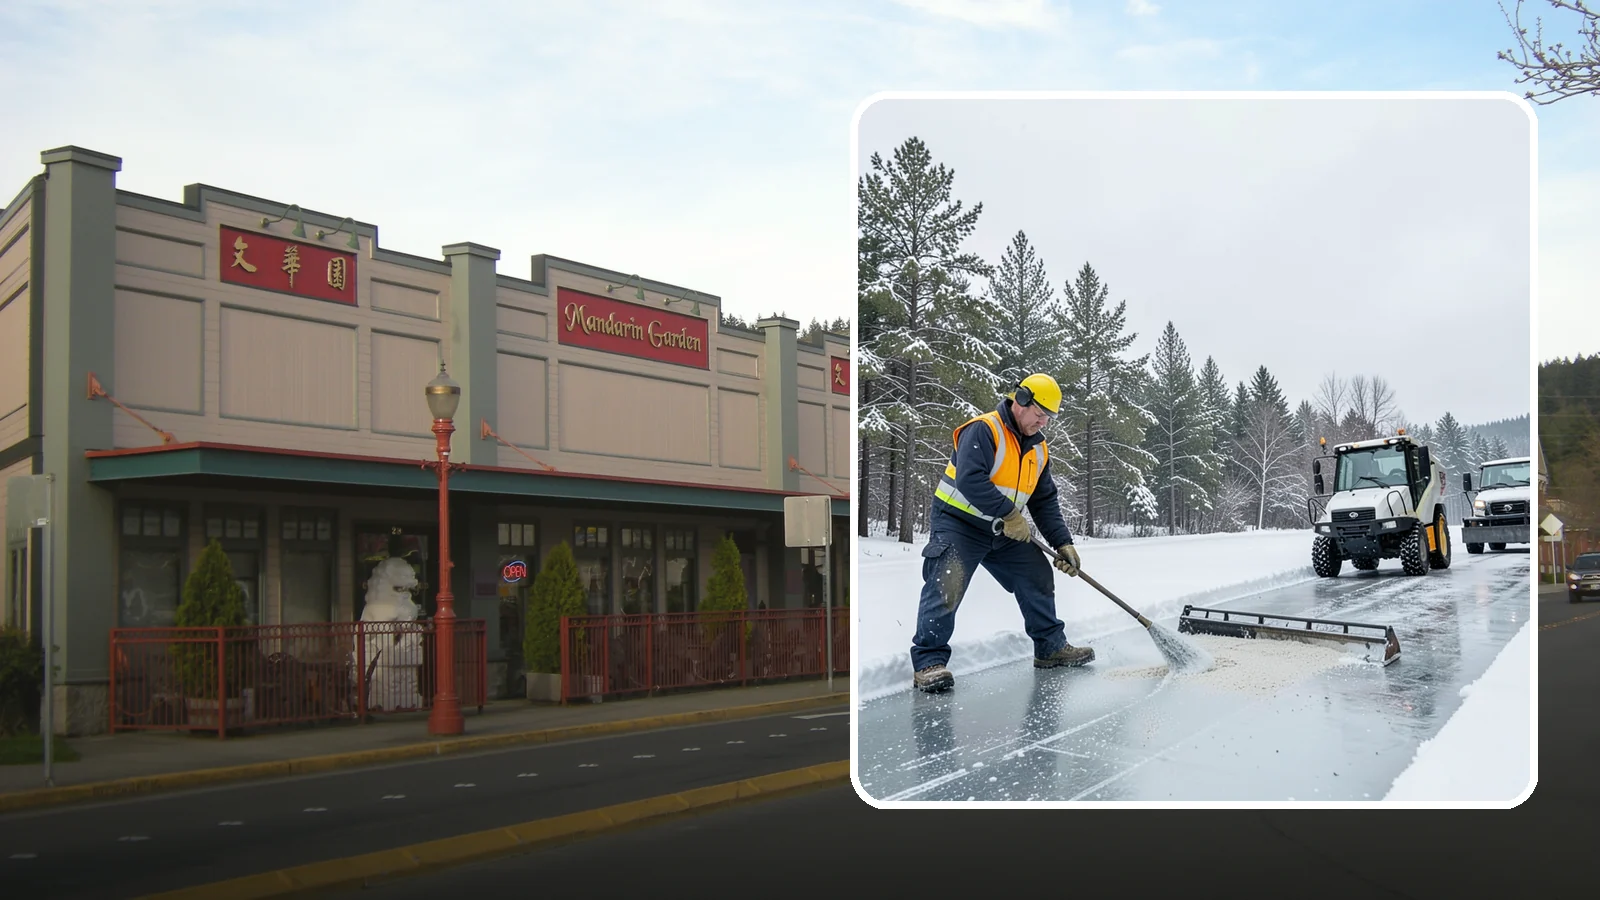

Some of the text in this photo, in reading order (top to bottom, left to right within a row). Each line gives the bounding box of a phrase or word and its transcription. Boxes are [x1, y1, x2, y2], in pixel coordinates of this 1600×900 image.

[231, 235, 346, 291] 文華園
[564, 302, 701, 352] Mandarin Garden
[834, 363, 846, 386] 文
[503, 565, 527, 578] OPEN
